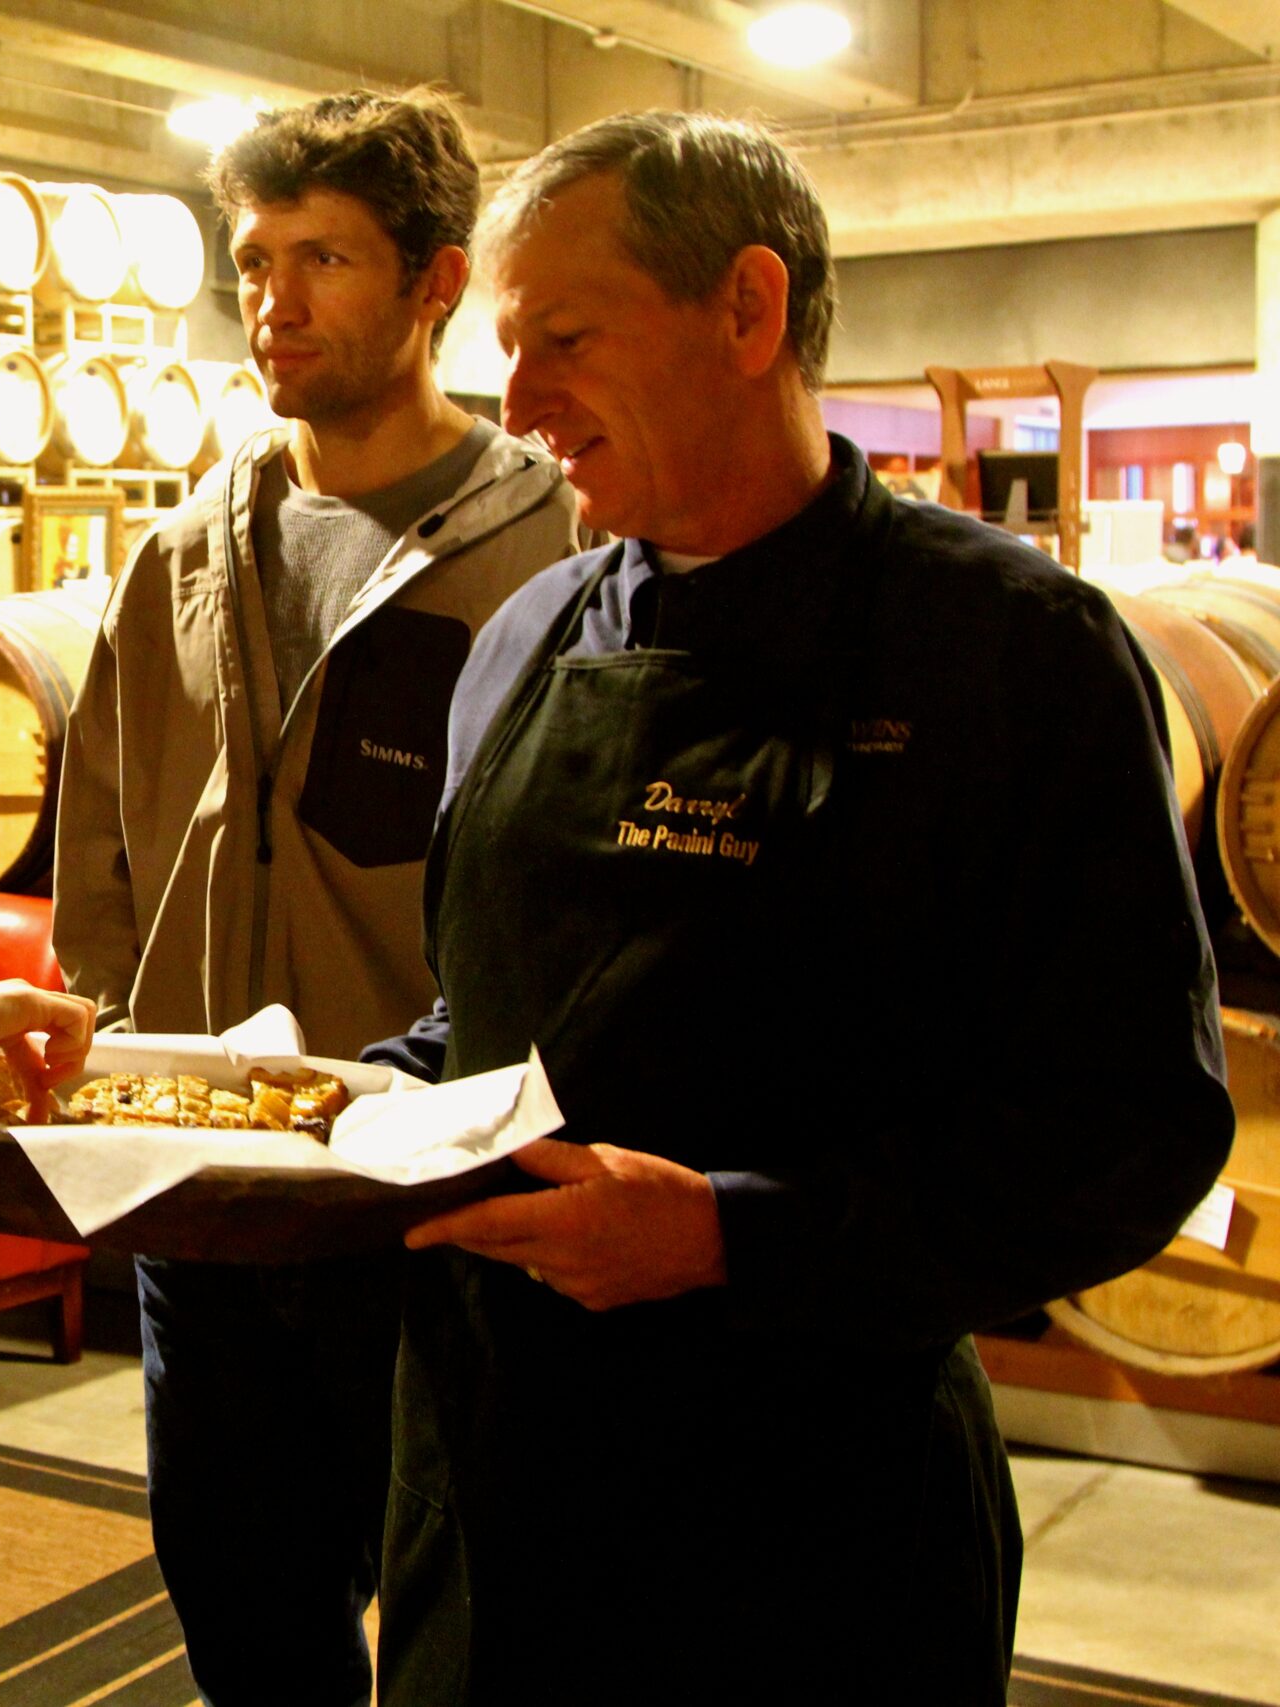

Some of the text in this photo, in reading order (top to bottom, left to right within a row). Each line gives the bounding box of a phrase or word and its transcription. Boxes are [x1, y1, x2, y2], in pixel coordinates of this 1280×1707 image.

[359, 738, 425, 770] SIMMS
[644, 781, 746, 825] Darryl
[617, 820, 760, 867] The Panini Guy
